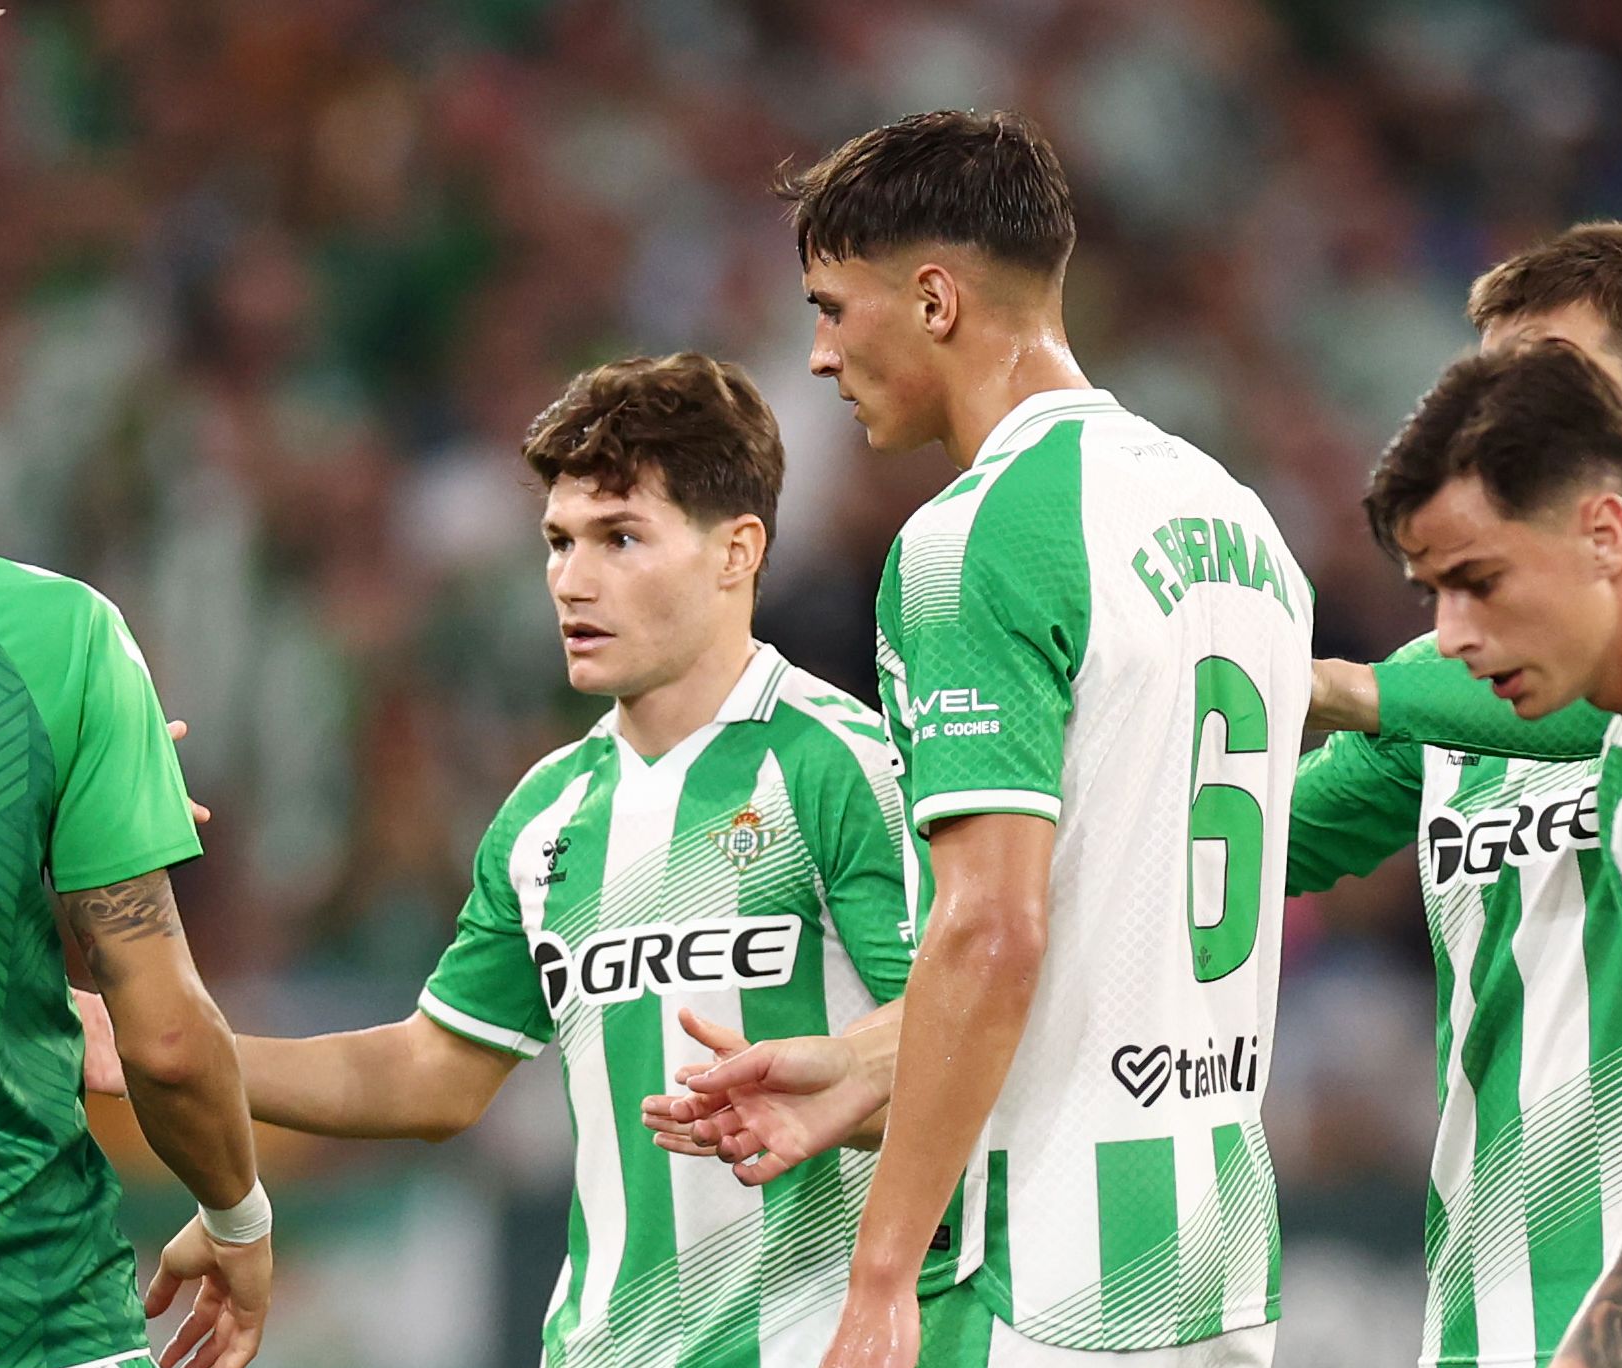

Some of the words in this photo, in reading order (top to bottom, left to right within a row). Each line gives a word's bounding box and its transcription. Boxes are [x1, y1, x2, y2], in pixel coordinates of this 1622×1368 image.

[912, 688, 1000, 715] VEL
[922, 724, 937, 739] DE
[943, 720, 1000, 737] COCHES
[1187, 655, 1268, 983] 6
[580, 926, 793, 996] GREE
